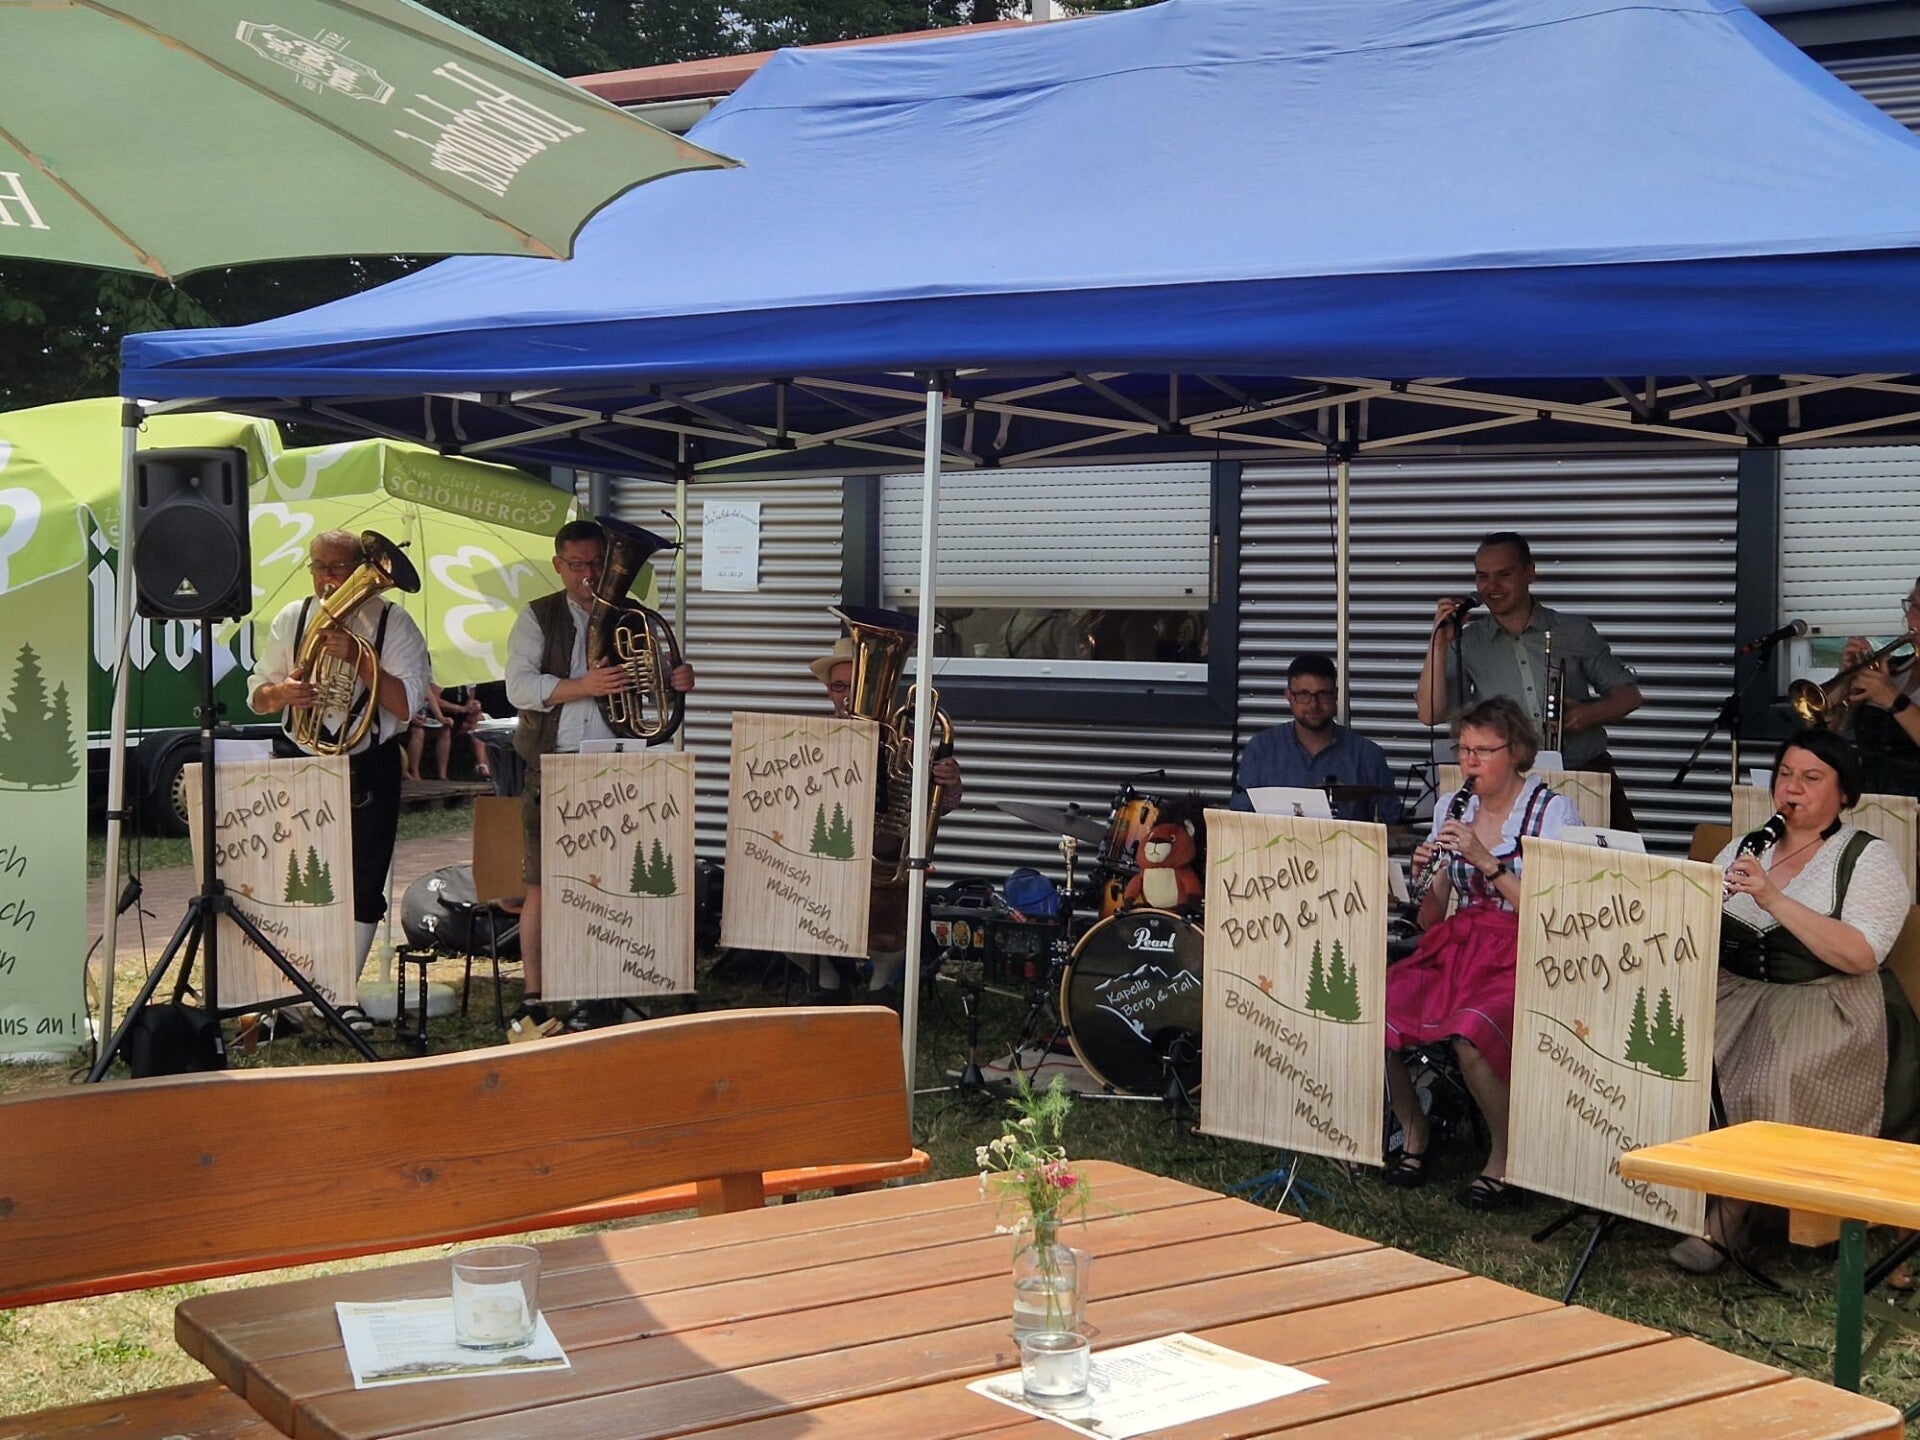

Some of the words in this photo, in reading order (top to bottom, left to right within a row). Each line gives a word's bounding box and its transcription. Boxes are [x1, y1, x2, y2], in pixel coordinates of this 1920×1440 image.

[390, 475, 527, 523] SCHÖMBERG
[746, 744, 824, 782] Kapelle
[557, 782, 638, 826] Kapelle
[743, 782, 799, 812] Berg
[804, 776, 822, 796] &
[823, 760, 862, 789] Tal
[215, 789, 290, 829] apelle
[272, 821, 291, 842] &
[291, 800, 336, 832] Tal
[556, 825, 616, 857] Berg
[620, 814, 638, 835] &
[639, 794, 681, 824] Tal
[744, 841, 812, 886] Böhmisch
[1223, 855, 1319, 904] Kapelle
[562, 889, 633, 929] Böhmisch
[766, 876, 831, 921] Mährisch
[1220, 911, 1291, 948] Berg
[1296, 899, 1318, 929] &
[1318, 880, 1369, 919] Tal
[1540, 893, 1645, 941] Kapelle
[587, 922, 656, 961] Mährisch
[798, 917, 849, 953] Modern
[1128, 927, 1176, 951] Pearl
[622, 959, 677, 992] Modern
[1536, 953, 1611, 991] Berg
[1617, 941, 1642, 973] &
[1643, 925, 1700, 967] Tal
[1106, 978, 1150, 1004] Kapelle
[1121, 996, 1156, 1017] Berg
[1157, 989, 1168, 1002] &
[1168, 977, 1192, 996] Tal
[36, 1017, 63, 1035] an
[1225, 989, 1308, 1056] Böhmisch
[1254, 1039, 1334, 1108] Mährisch
[1538, 1032, 1627, 1112] Böhmisch
[1294, 1097, 1360, 1156] Modern
